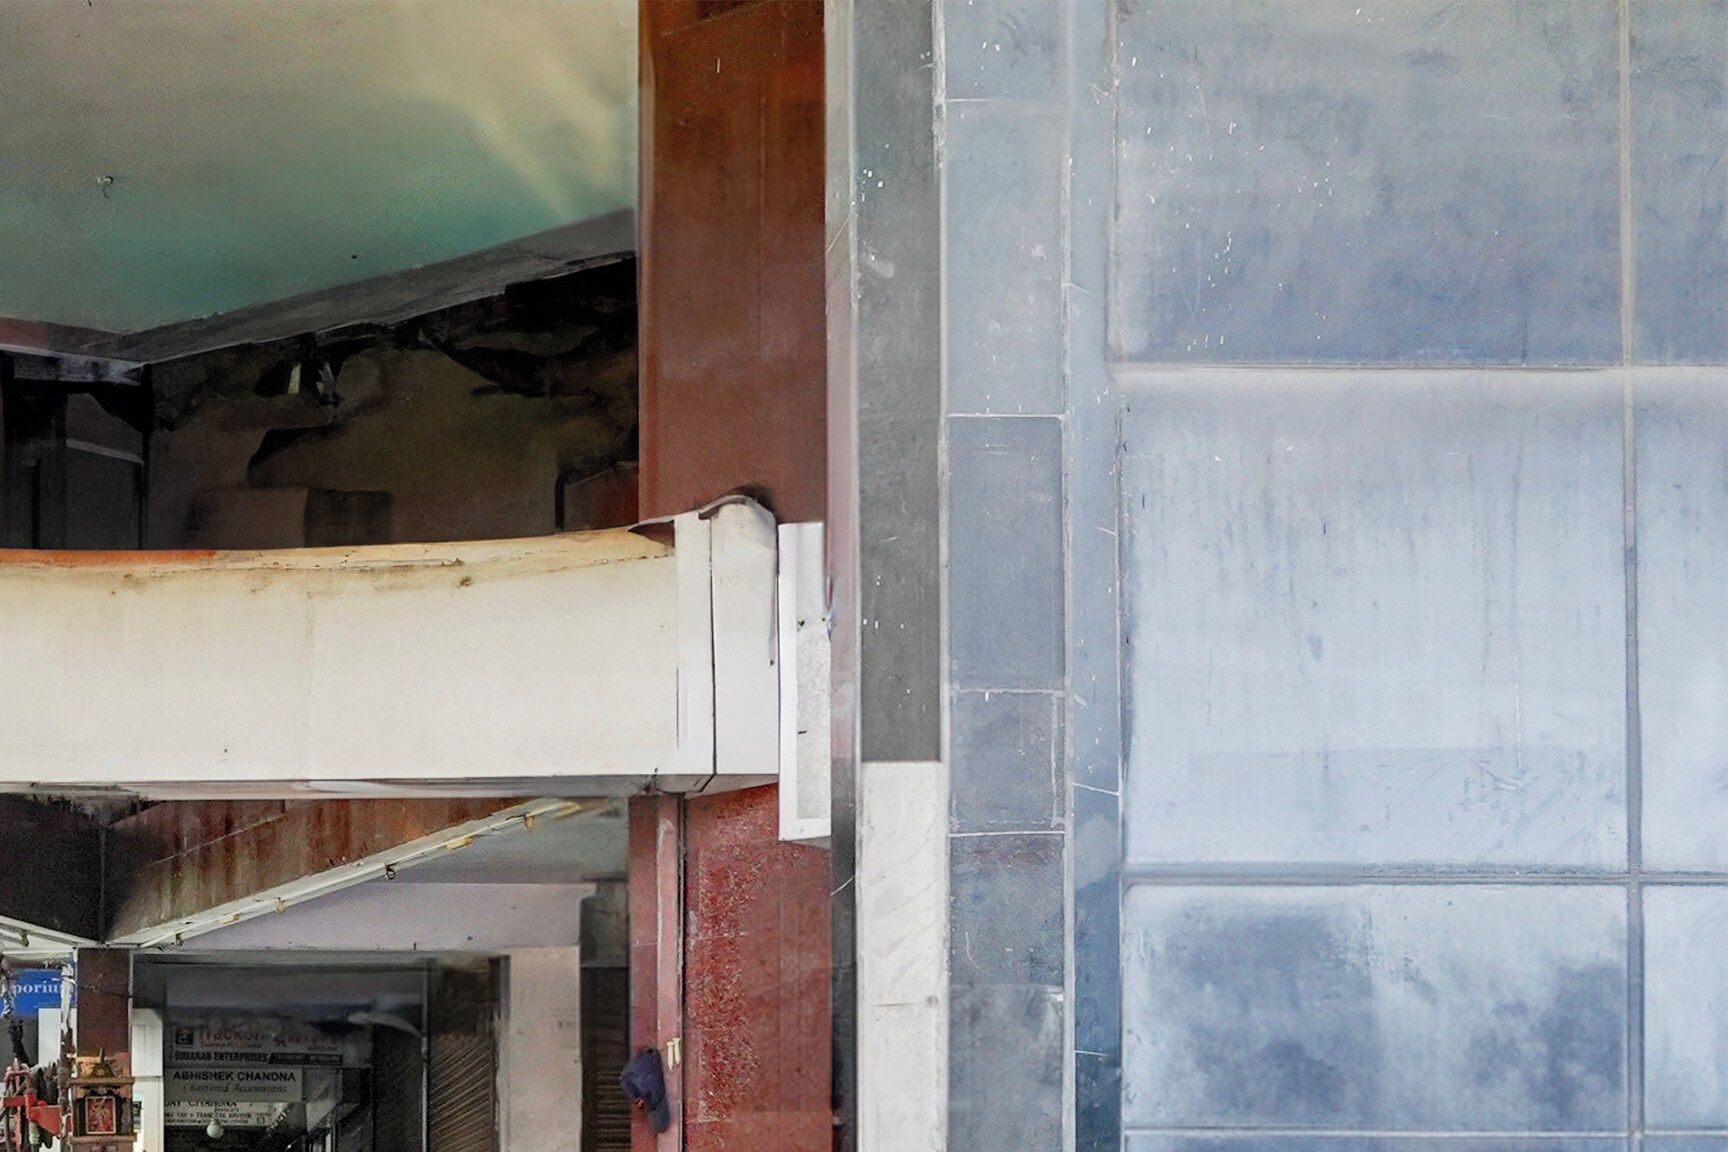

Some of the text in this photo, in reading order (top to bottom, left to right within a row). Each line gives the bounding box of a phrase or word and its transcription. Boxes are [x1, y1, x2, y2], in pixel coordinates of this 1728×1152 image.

[13, 980, 62, 998] poriu
[173, 1071, 296, 1082] ABHISHEK CHANDNA
